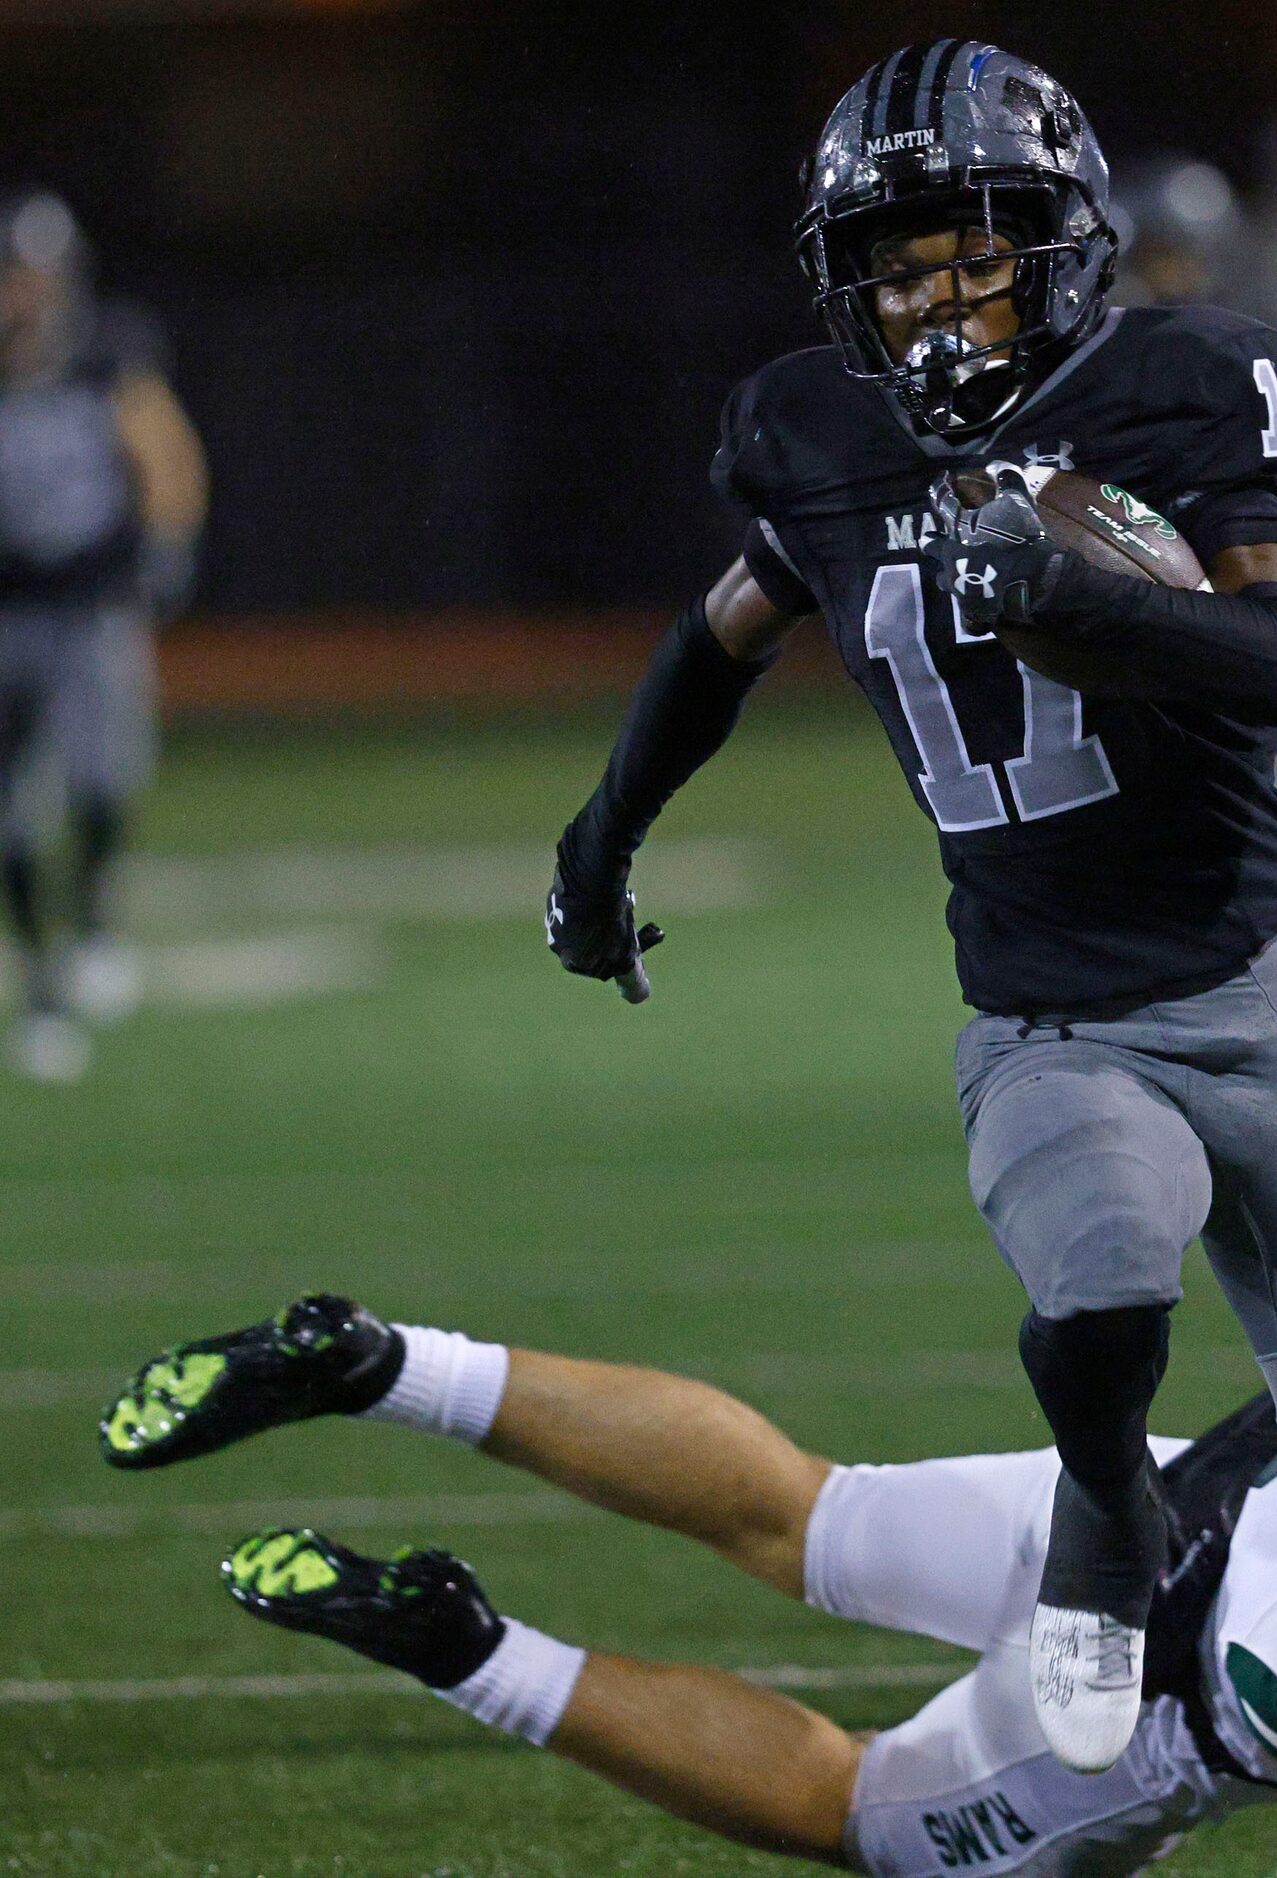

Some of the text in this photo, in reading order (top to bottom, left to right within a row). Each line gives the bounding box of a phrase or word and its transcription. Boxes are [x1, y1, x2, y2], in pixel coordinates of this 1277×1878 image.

[866, 129, 935, 157] MARTIN
[1086, 504, 1125, 531] TEAM
[1123, 530, 1162, 560] ISSUE
[922, 1790, 1037, 1868] RAMS
